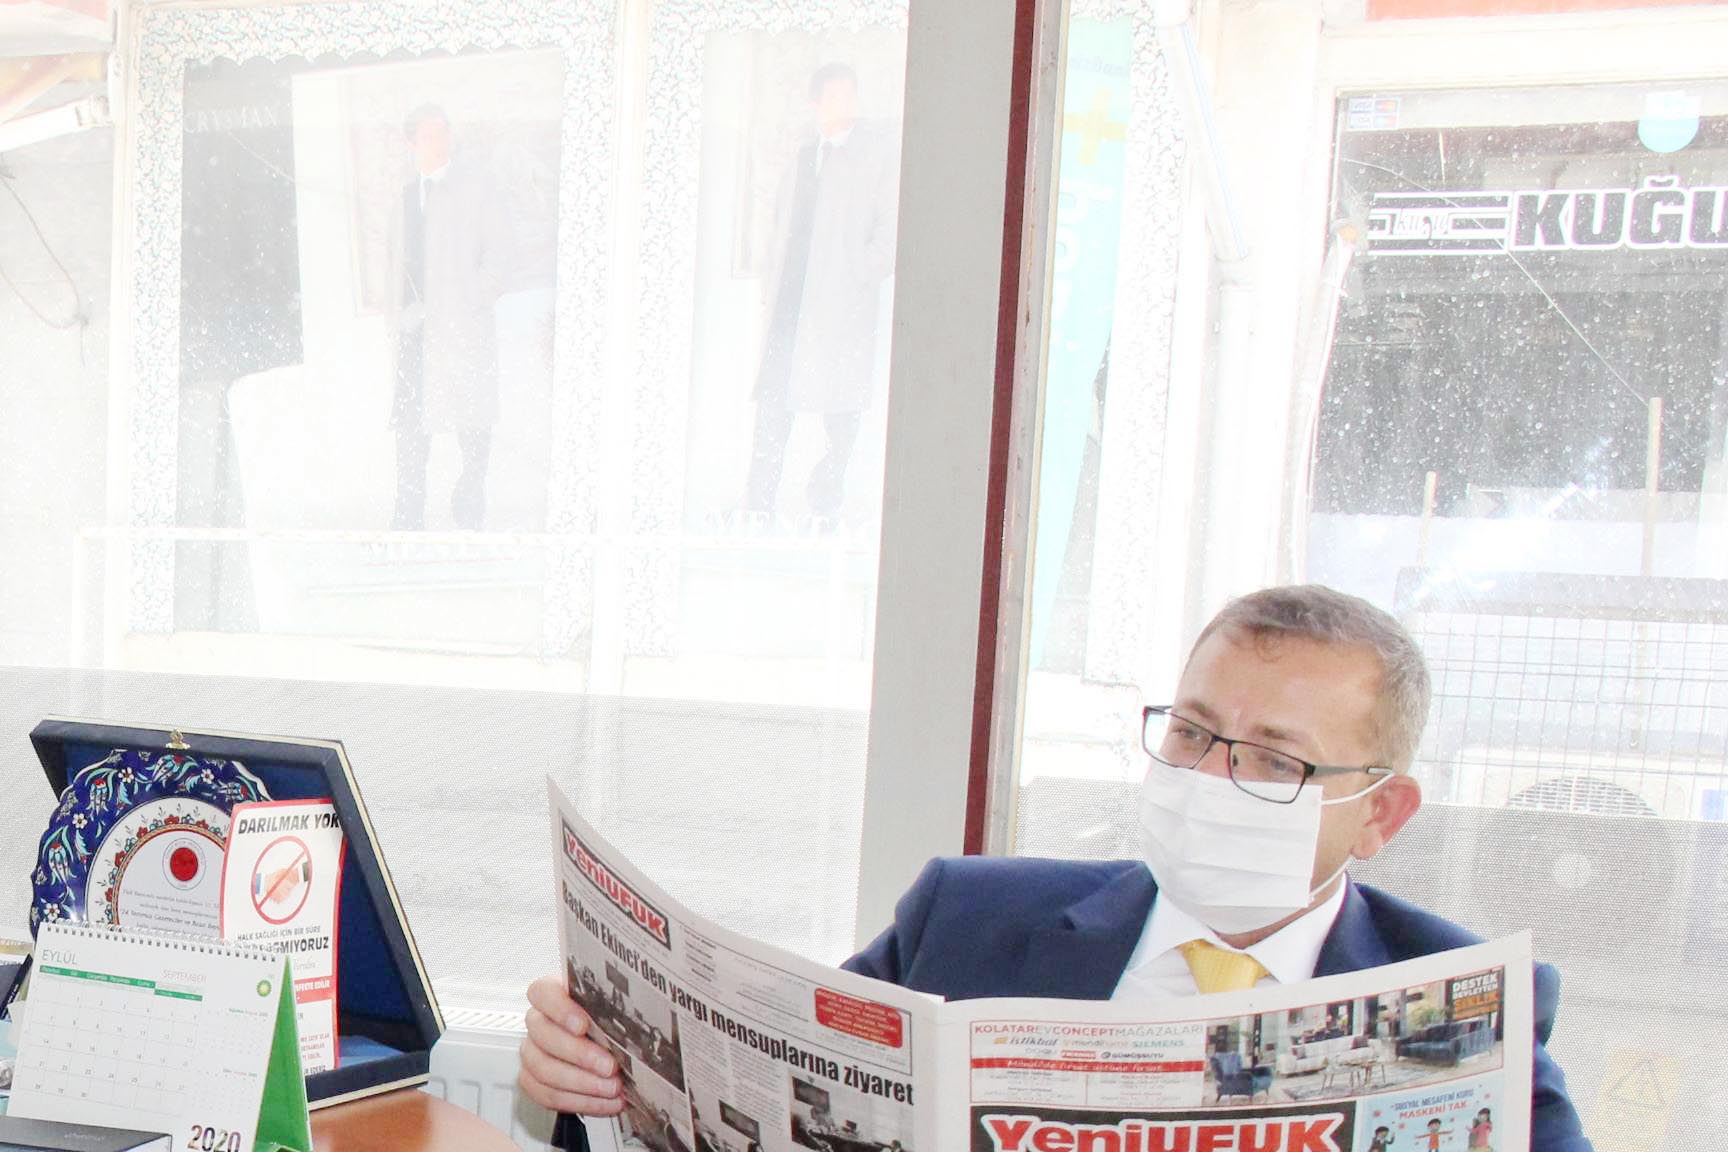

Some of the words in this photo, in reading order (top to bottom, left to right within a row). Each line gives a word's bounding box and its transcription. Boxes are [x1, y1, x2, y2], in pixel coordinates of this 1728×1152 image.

[238, 813, 310, 835] DARILMAK
[600, 922, 667, 995] Ekinci'den
[668, 980, 709, 1023] yargı
[711, 1008, 840, 1083] mensuplarına
[843, 1064, 915, 1107] ziyaret
